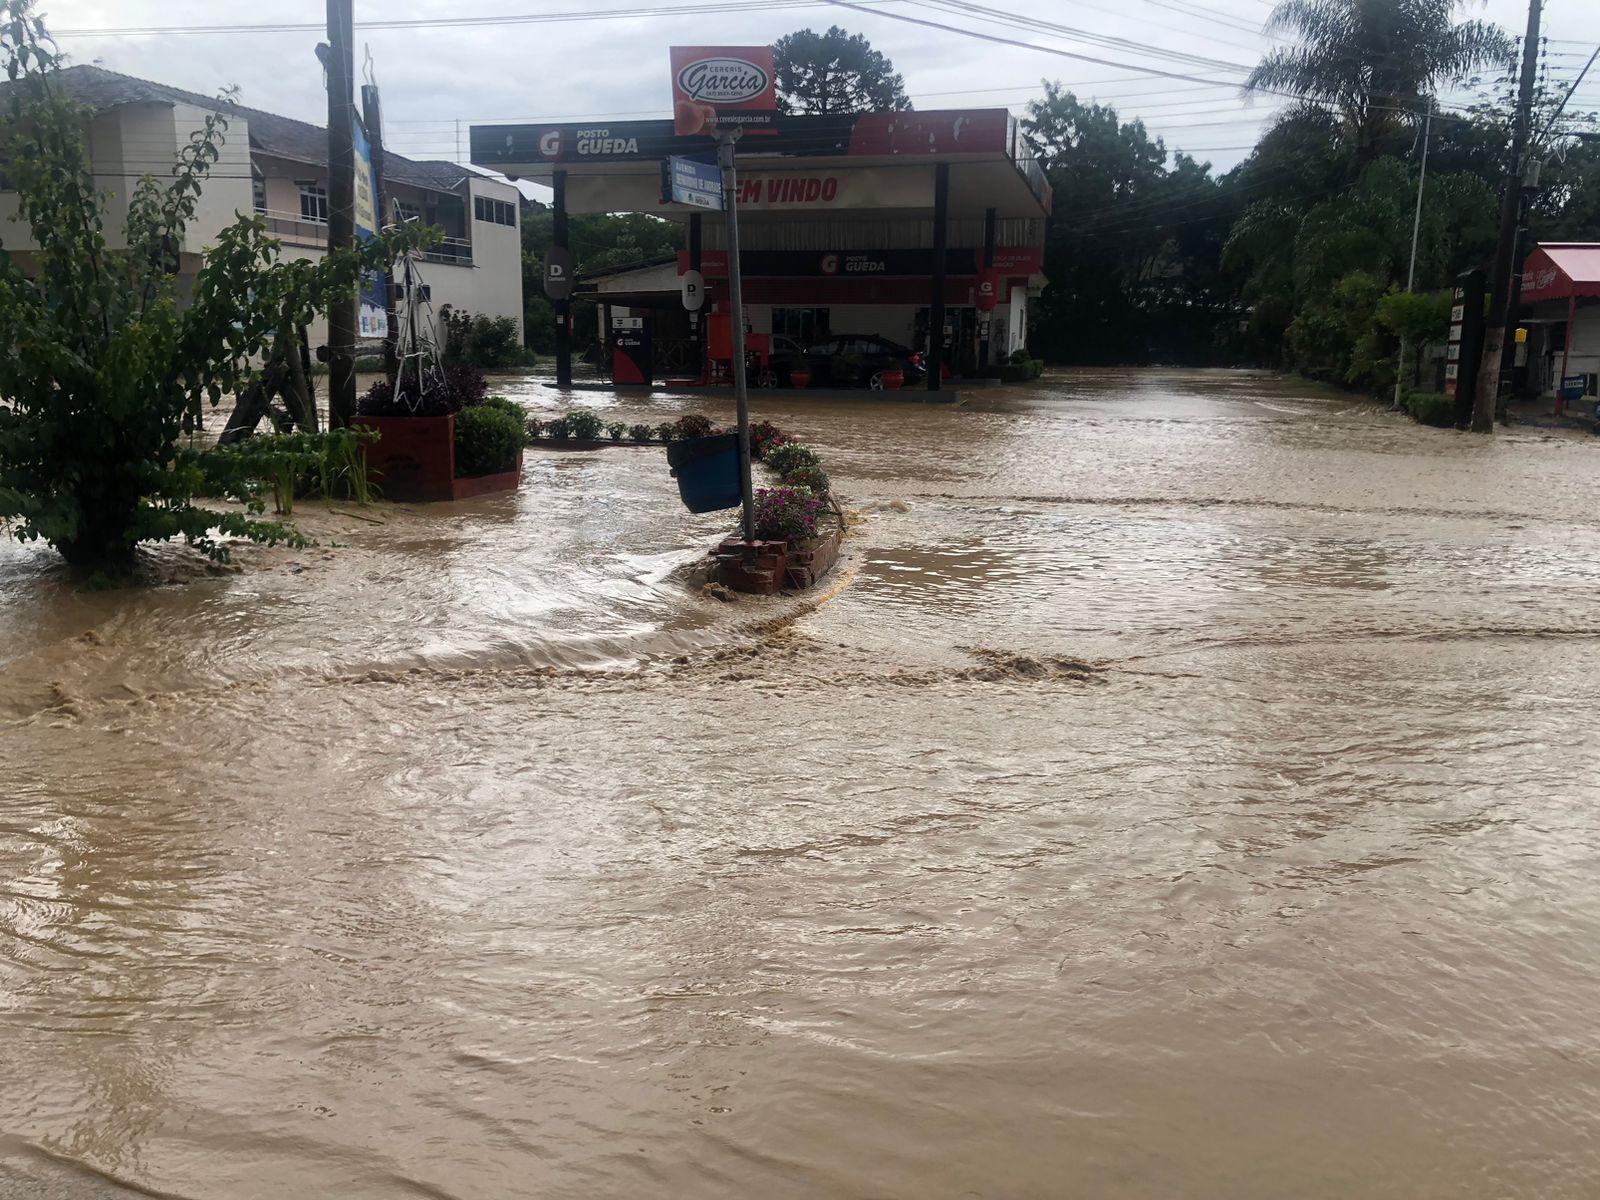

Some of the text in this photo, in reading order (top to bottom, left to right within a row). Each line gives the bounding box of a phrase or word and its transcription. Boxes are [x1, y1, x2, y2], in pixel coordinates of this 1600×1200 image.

[688, 64, 761, 99] Garcia
[577, 129, 610, 138] POSTO
[577, 138, 639, 154] GUEDA
[768, 178, 837, 203] VINDO
[845, 261, 886, 272] GUEDA
